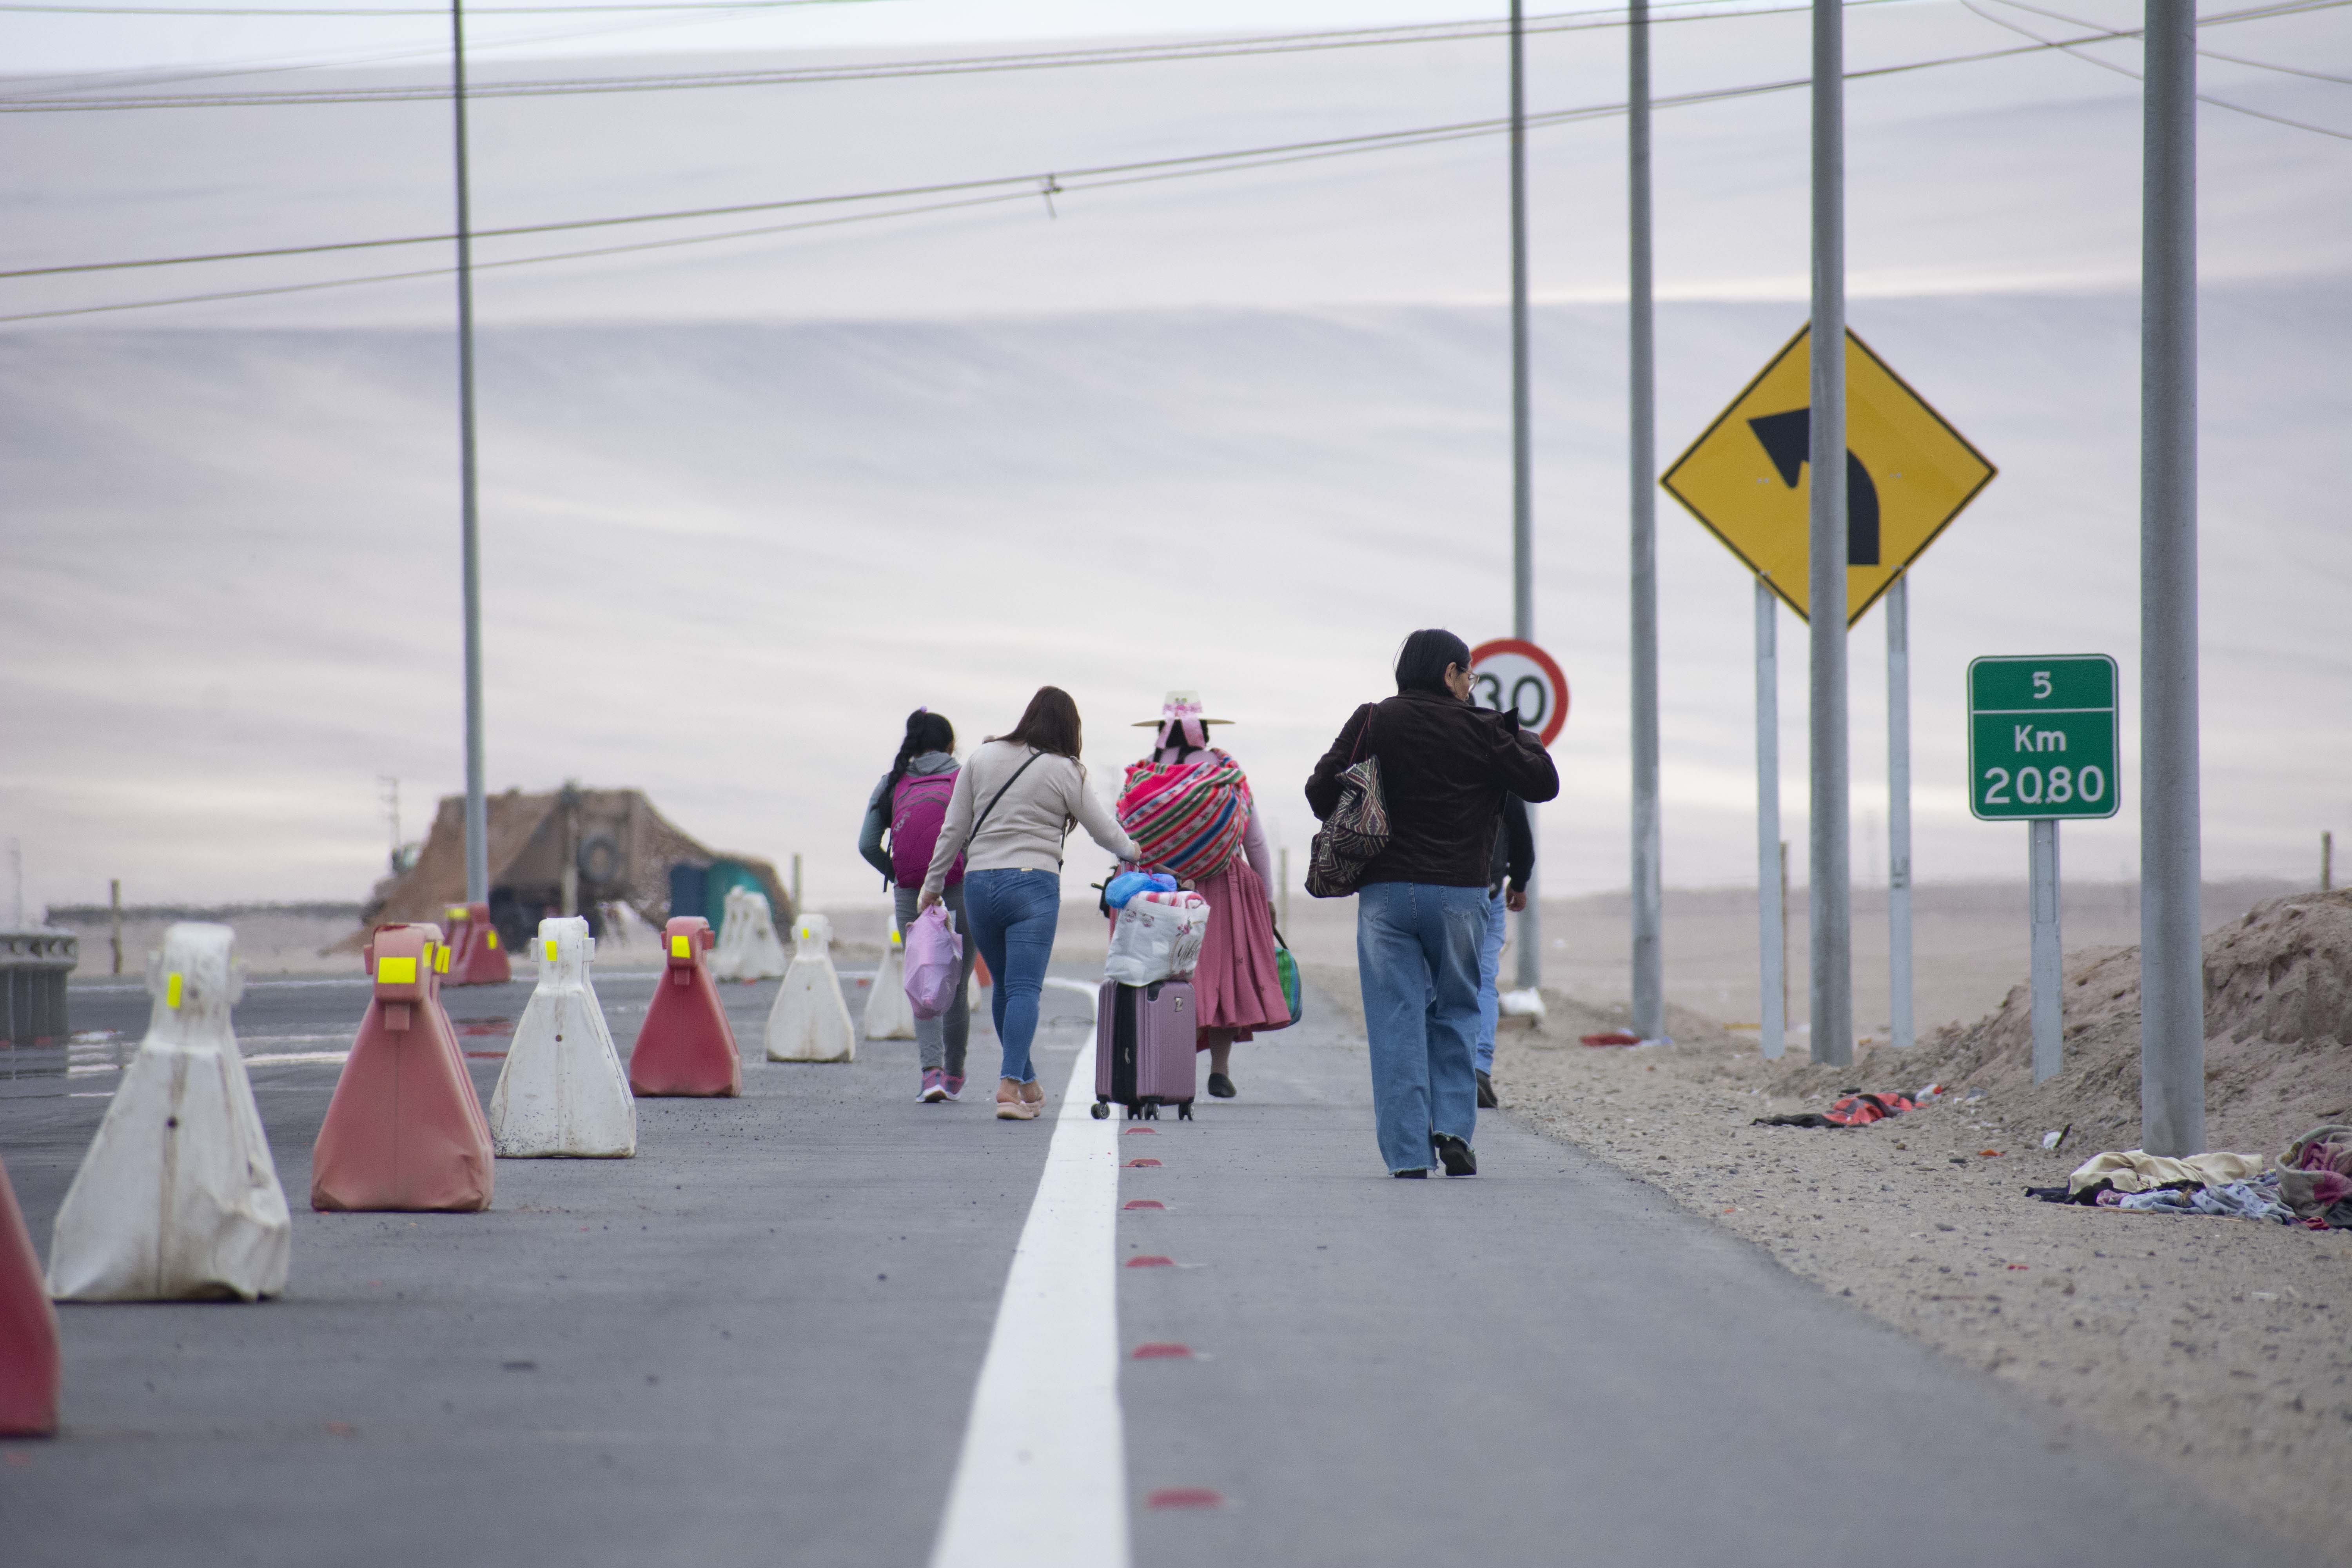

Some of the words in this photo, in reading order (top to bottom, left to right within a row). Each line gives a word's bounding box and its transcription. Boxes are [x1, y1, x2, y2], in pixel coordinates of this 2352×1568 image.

[1478, 673, 1546, 728] 30
[2032, 671, 2053, 699] 5
[2014, 724, 2067, 752] Km
[1984, 765, 2105, 804] 2080
